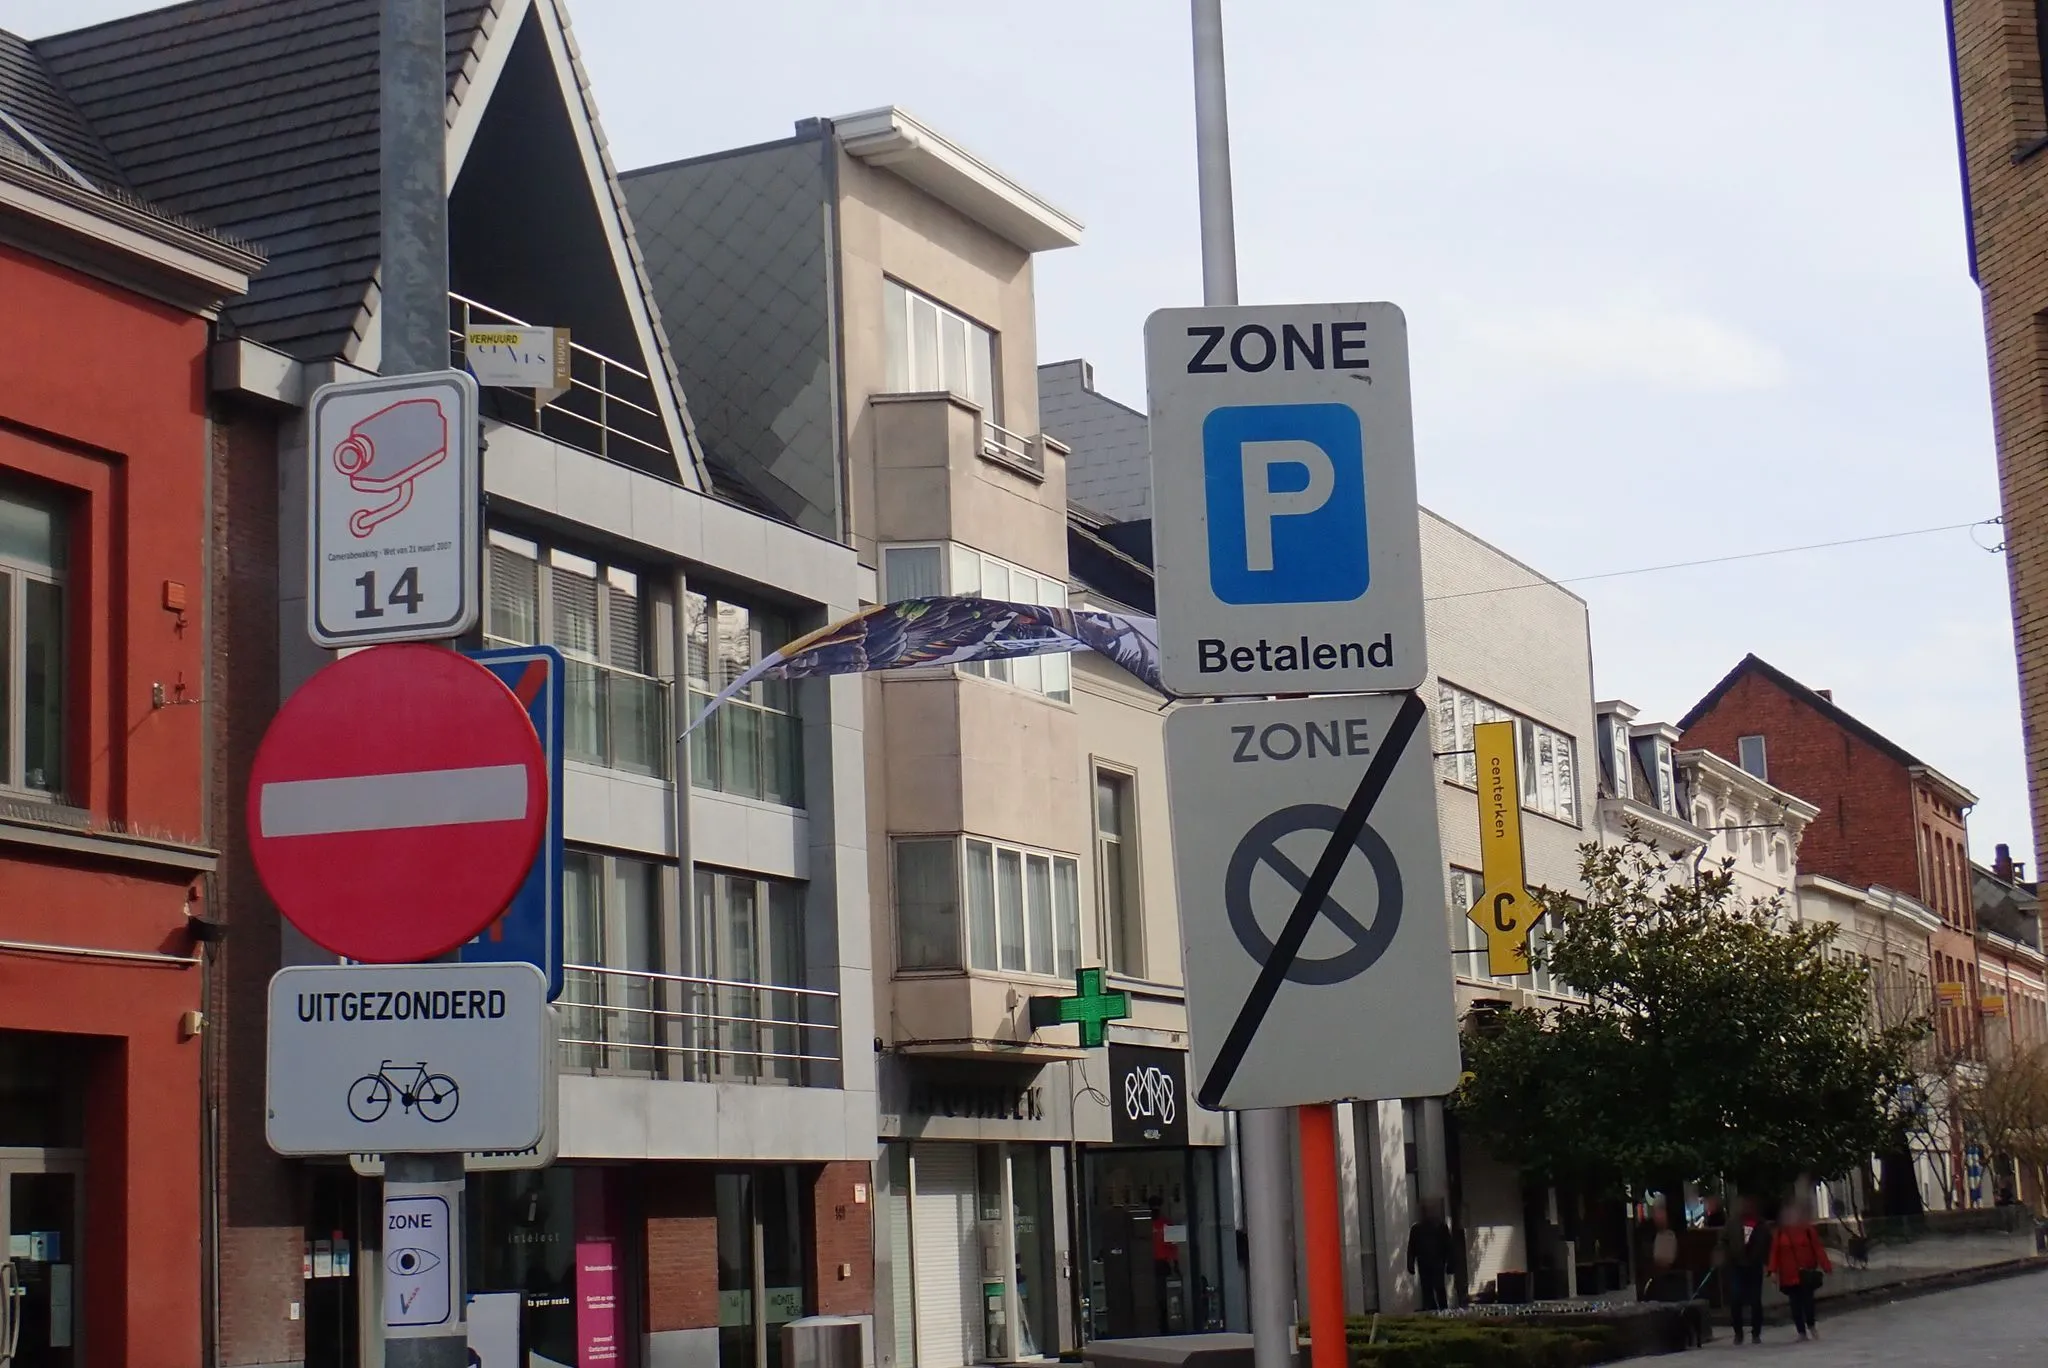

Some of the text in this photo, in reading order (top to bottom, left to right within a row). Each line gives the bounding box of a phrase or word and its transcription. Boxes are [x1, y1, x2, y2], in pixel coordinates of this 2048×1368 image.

[469, 334, 518, 344] VERHUURD
[1187, 321, 1370, 374] ZONE
[1240, 439, 1335, 572] P
[328, 549, 378, 562] Camerabewaking
[383, 548, 396, 556] Wet
[409, 545, 416, 553] 21
[355, 566, 424, 619] 14
[1197, 632, 1395, 674] Betalend
[1230, 718, 1370, 763] ZONE
[1491, 757, 1508, 838] centerken
[1493, 892, 1517, 932] C
[297, 989, 506, 1023] UITGEZONDERD
[388, 1213, 433, 1230] ZONE
